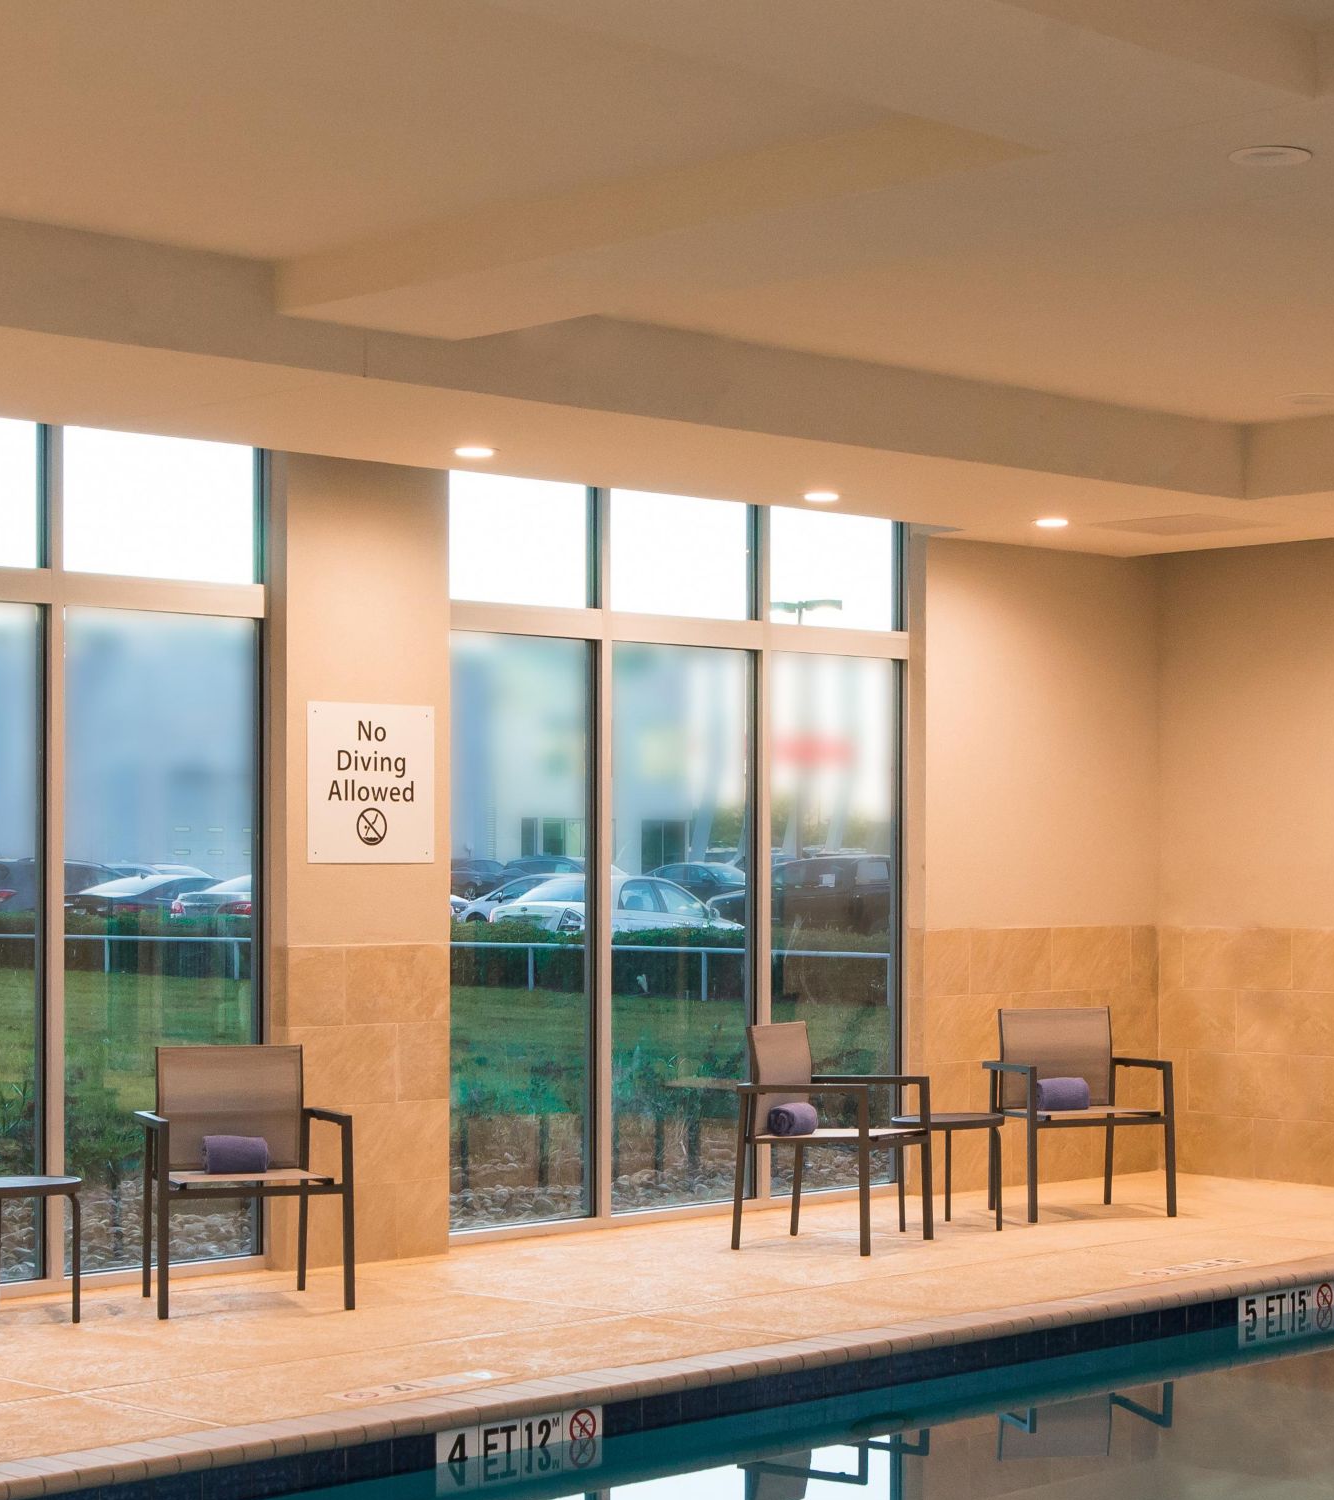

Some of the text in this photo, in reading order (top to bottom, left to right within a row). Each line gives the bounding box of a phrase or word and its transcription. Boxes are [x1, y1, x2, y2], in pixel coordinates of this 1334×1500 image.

[357, 720, 387, 742] No
[336, 749, 406, 779] Diving
[327, 779, 415, 803] Allowed
[1245, 1298, 1258, 1323] 5
[1265, 1293, 1287, 1319] FT
[447, 1432, 469, 1463] 4
[483, 1424, 518, 1458] FT
